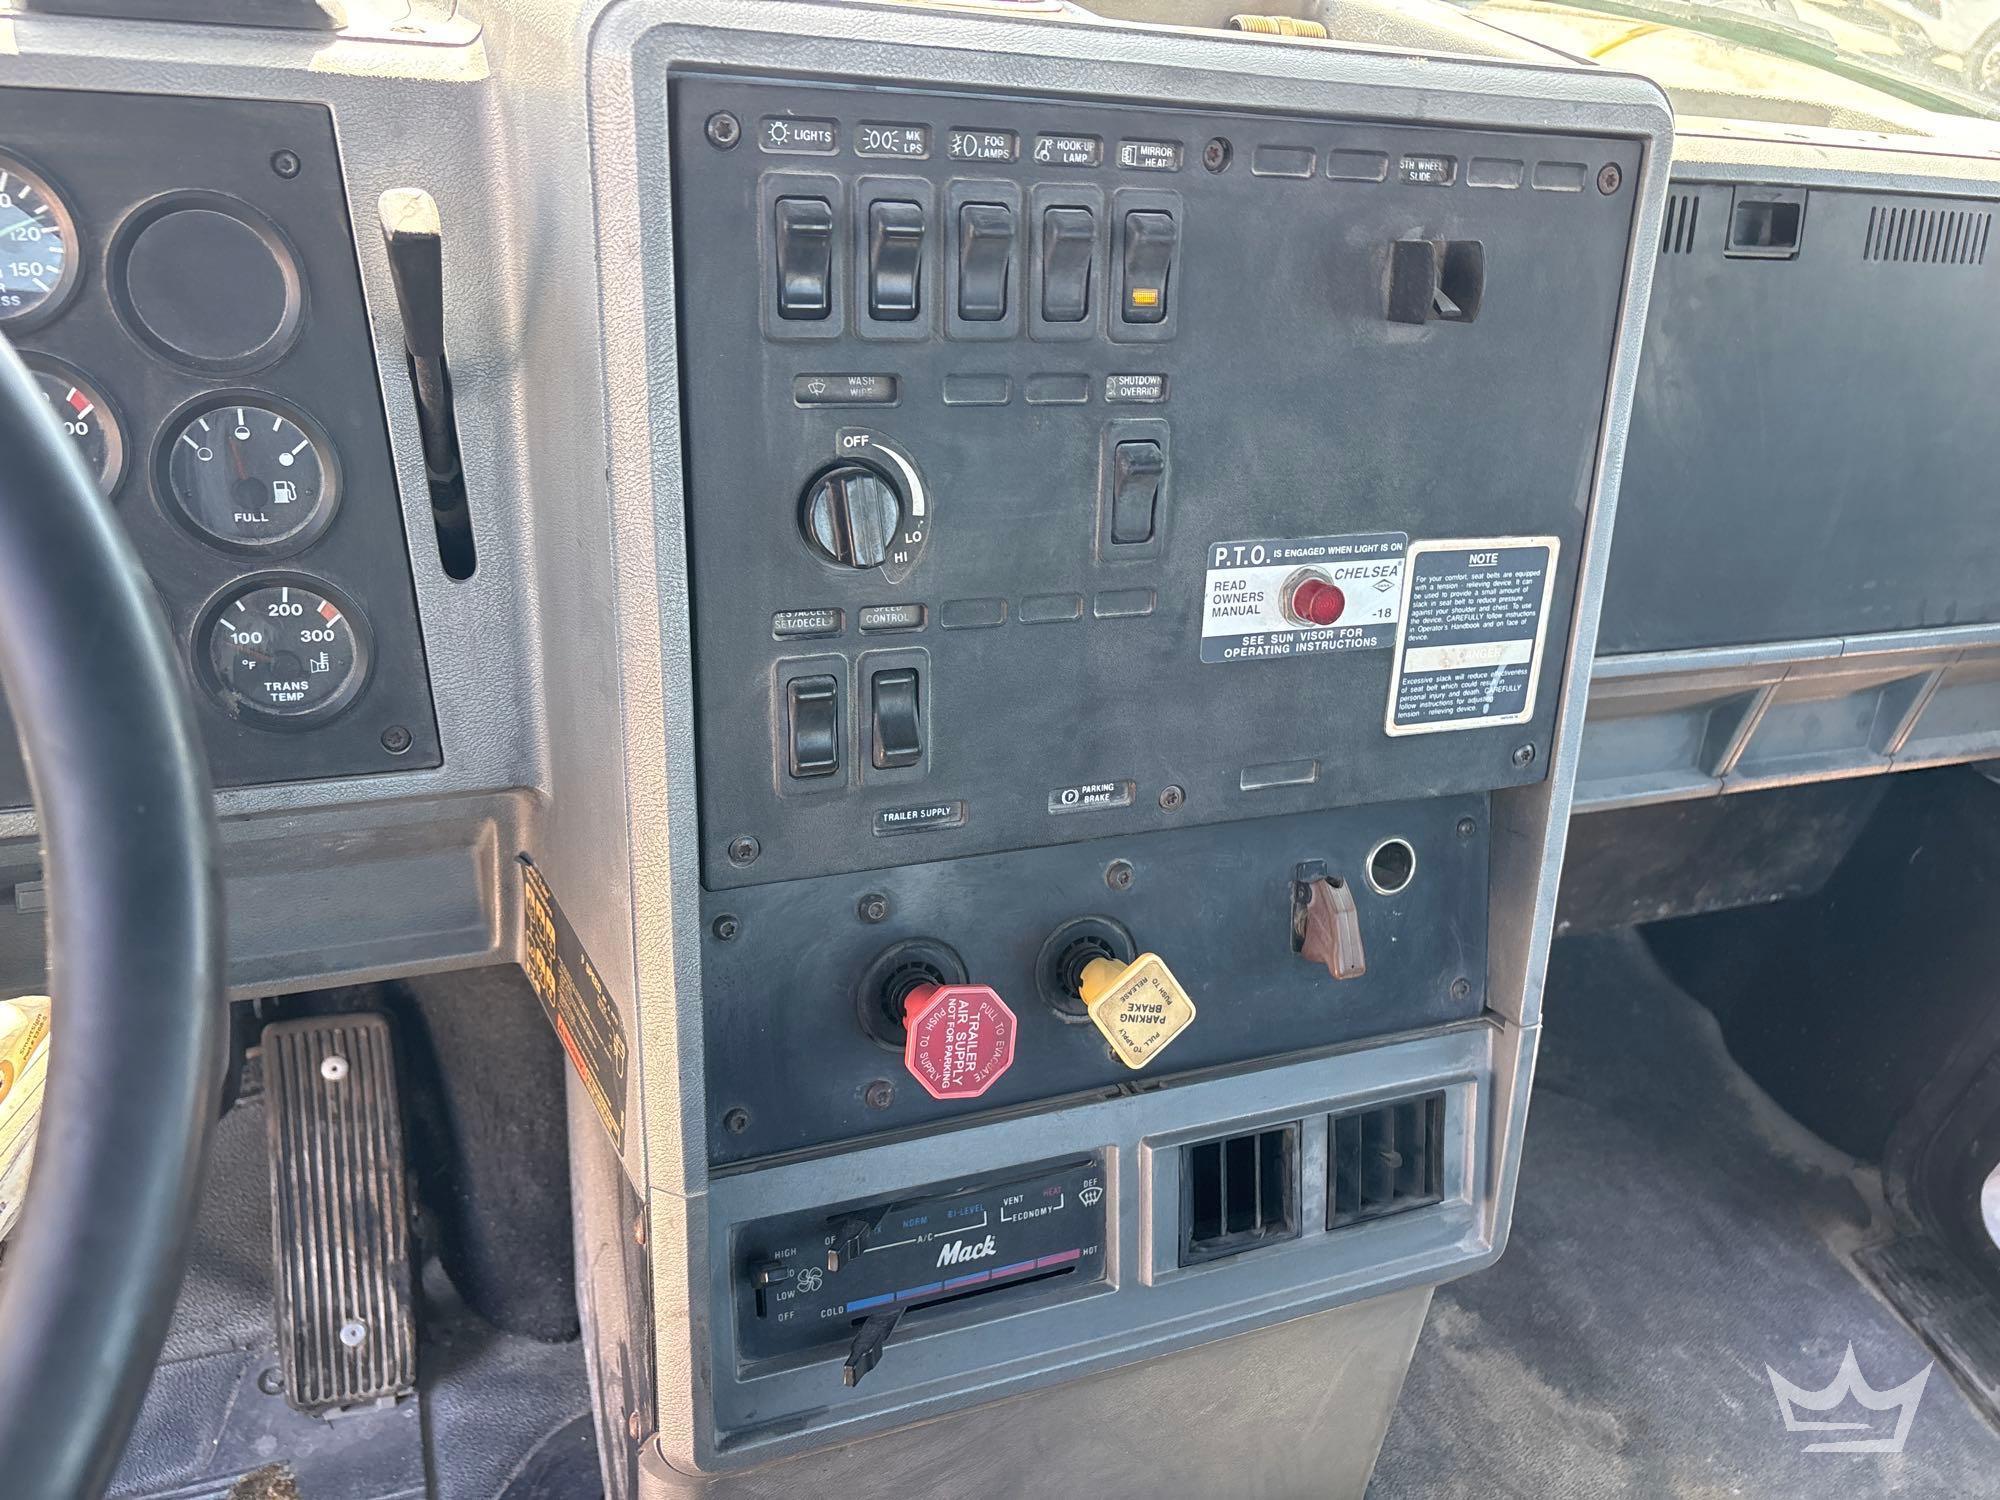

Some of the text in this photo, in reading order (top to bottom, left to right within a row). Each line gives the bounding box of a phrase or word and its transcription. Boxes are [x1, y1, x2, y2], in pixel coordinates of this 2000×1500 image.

[794, 129, 831, 142] LIGHTS
[906, 131, 920, 141] MK
[984, 136, 1004, 146] FOG
[904, 143, 922, 154] LPS
[1057, 140, 1095, 152] HOOK-UP
[1140, 146, 1172, 157] MIRROR
[978, 148, 1009, 159] LAMPS
[1064, 153, 1088, 162] LAMP
[1145, 158, 1167, 168] HEAT
[1418, 161, 1442, 170] WHEEL
[1410, 172, 1430, 182] SLIDE
[10, 226, 41, 242] 120
[9, 262, 44, 277] 150
[848, 376, 875, 386] WASH
[1118, 376, 1162, 386] SHUTDOWN
[1120, 386, 1160, 396] OVERRIDE
[843, 435, 870, 448] OFF
[234, 513, 269, 522] FULL
[905, 530, 922, 544] LO
[894, 550, 908, 564] HI
[1215, 542, 1402, 566] P.T.O. IS ENGAGED WHEN LIGHT IS ON
[1469, 553, 1498, 564] NOTE
[1334, 565, 1398, 580] CHELSEA
[1429, 576, 1442, 584] your
[1514, 570, 1540, 578] equipped
[1214, 580, 1246, 591] READ
[1212, 592, 1264, 604] OWNERS
[1450, 590, 1472, 598] provide
[1498, 596, 1524, 604] pressure
[268, 604, 303, 616] 200
[1212, 605, 1261, 618] MANUAL
[1372, 608, 1392, 618] -18
[1412, 610, 1433, 618] against
[1436, 608, 1449, 616] your
[1452, 606, 1476, 614] shoulder
[1512, 602, 1520, 610] To
[1446, 613, 1484, 622] CAREFULLY
[1505, 610, 1536, 618] instructions
[774, 618, 826, 629] SET/DECEL
[866, 614, 910, 624] CONTROL
[1418, 624, 1448, 633] Operator's
[1450, 622, 1480, 630] Handbook
[230, 632, 262, 644] 100
[300, 630, 334, 642] 300
[1242, 628, 1363, 646] SEE SUN VISOR FOR
[1224, 637, 1378, 658] OPERATING INSTRUCTIONS
[264, 681, 309, 691] TRANS
[1402, 677, 1433, 686] Excessive
[1436, 674, 1452, 682] slack
[1441, 682, 1458, 690] which
[270, 692, 304, 702] TEMP
[1400, 694, 1426, 703] personal
[1429, 692, 1446, 700] injury
[1420, 700, 1453, 708] instructions
[1398, 710, 1420, 718] tension
[1082, 783, 1114, 794] PARKING
[1084, 794, 1110, 804] BRAKE
[884, 806, 950, 822] TRAILER SUPPLY
[1120, 976, 1173, 1006] PUSH TO RELEASE
[1128, 1002, 1162, 1013] BRAKE
[980, 1002, 998, 1022] PULL
[995, 1022, 1004, 1035] TO
[1120, 1013, 1166, 1024] PARKING
[942, 998, 957, 1088] NOT FOR PARKING
[952, 1000, 969, 1086] AIR SUPPLY
[966, 1012, 980, 1072] TRAILER
[1119, 1028, 1134, 1047] APPLY
[1144, 1032, 1160, 1046] PULL
[920, 1008, 946, 1082] PUSH TO SUPPLY
[1084, 1178, 1098, 1188] DEF
[1042, 1186, 1062, 1197] HEAT
[1003, 1194, 1024, 1206] VENT
[948, 1204, 985, 1218] BI-LEVEL
[1012, 1206, 1053, 1222] ECONOMY
[903, 1216, 928, 1228] NORM
[918, 1232, 933, 1244] A/C
[774, 1248, 796, 1259] HIGH
[936, 1235, 997, 1268] Mack
[1083, 1246, 1098, 1256] HOT
[776, 1290, 796, 1302] LOW
[778, 1311, 795, 1322] OFF
[820, 1306, 844, 1318] COLD
